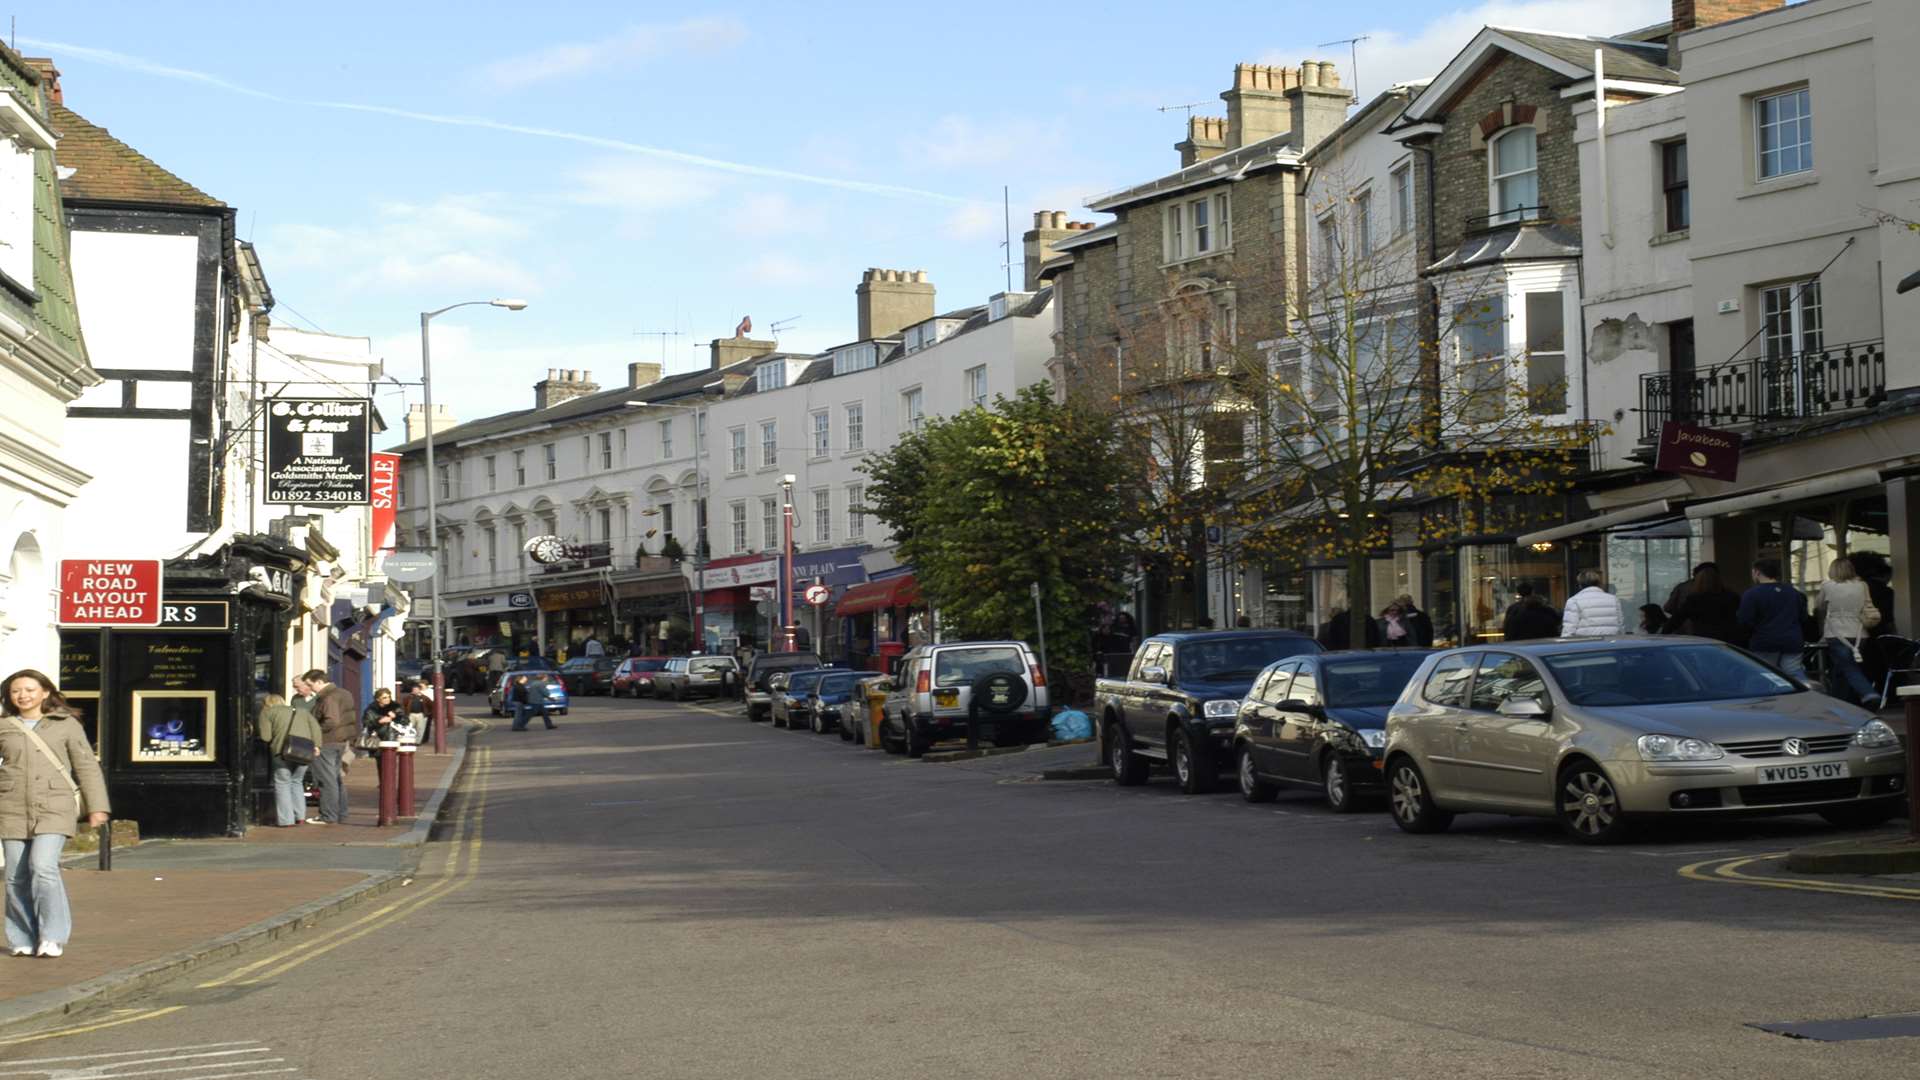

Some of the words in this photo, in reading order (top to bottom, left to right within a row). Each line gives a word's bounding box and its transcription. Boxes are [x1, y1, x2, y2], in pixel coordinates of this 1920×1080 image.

[325, 472, 364, 480] Member
[373, 460, 394, 509] SALE
[272, 491, 311, 501] 01892
[315, 491, 362, 501] 534018
[88, 563, 133, 575] NEW
[83, 578, 137, 590] ROAD
[73, 592, 147, 604] LAYOUT
[74, 606, 143, 618] AHEAD
[164, 606, 197, 622] RS
[1764, 766, 1809, 782] WV05
[1812, 763, 1842, 777] YOY
